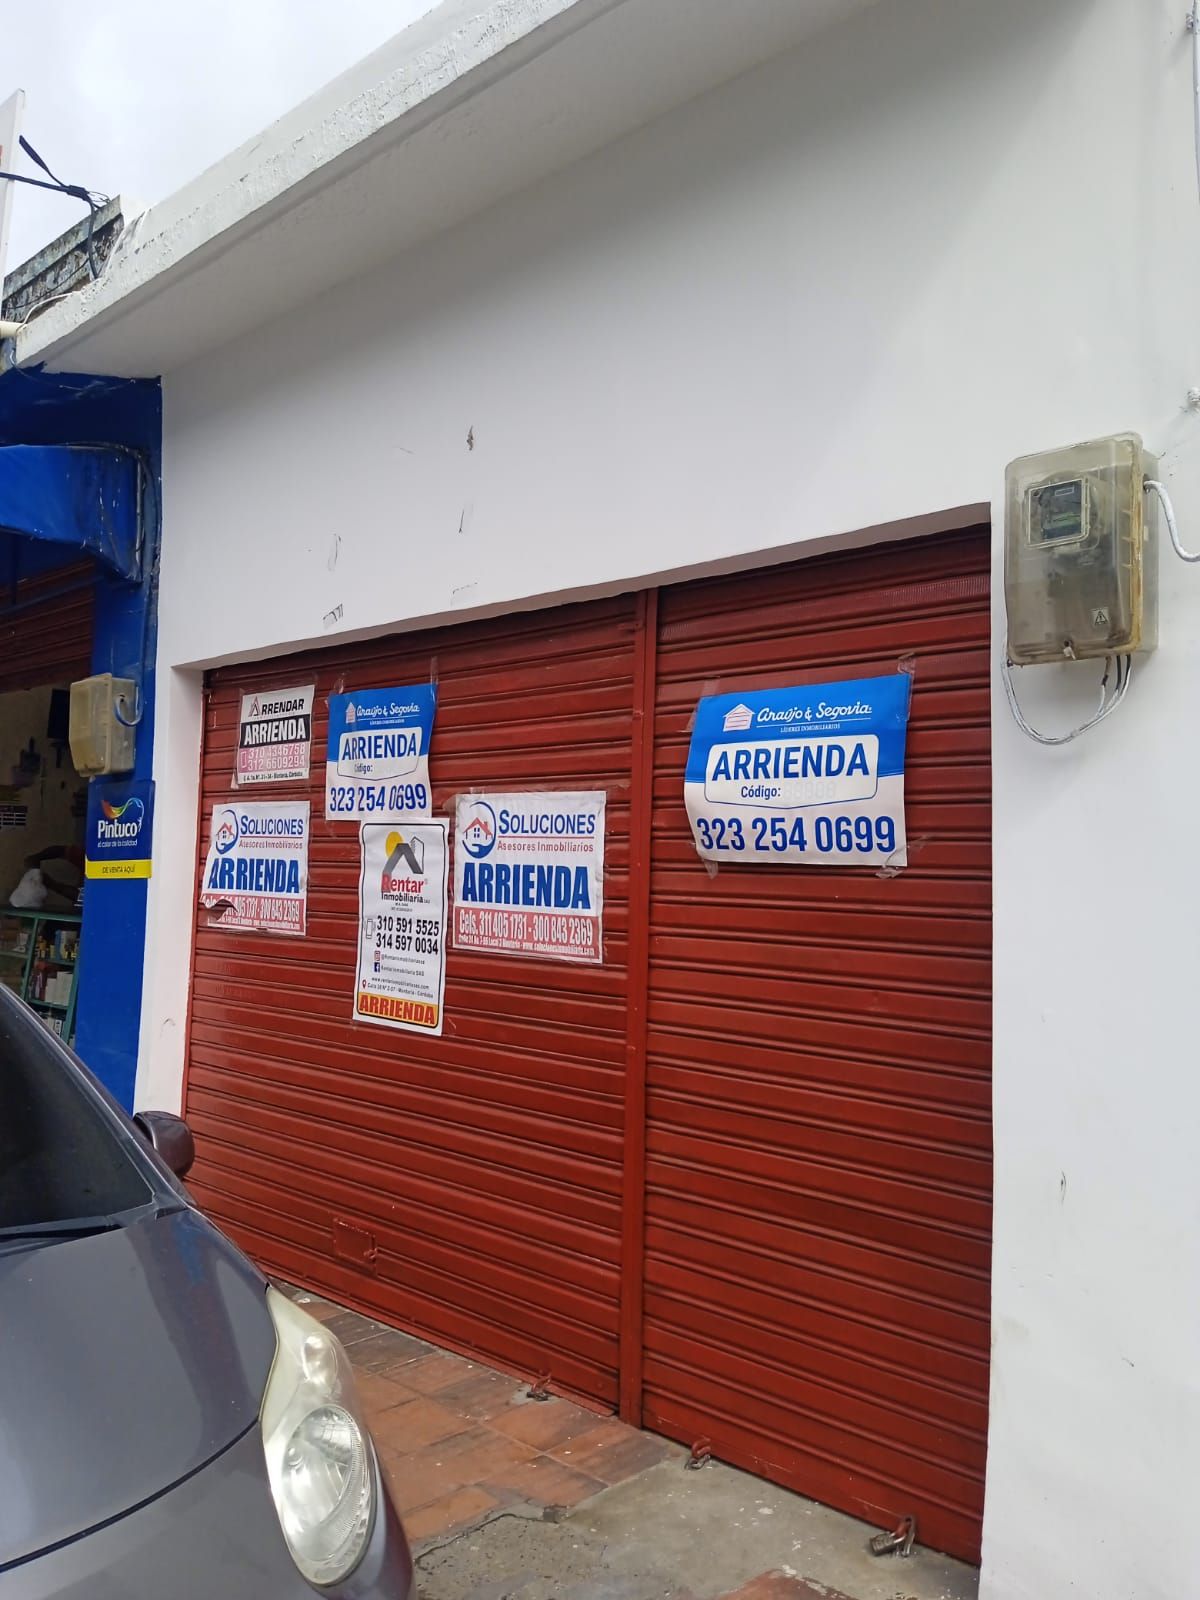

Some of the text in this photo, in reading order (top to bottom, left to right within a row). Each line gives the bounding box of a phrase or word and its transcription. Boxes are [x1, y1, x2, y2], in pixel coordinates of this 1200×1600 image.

[390, 702, 420, 716] Segovia
[804, 706, 813, 721] &
[816, 701, 870, 720] Segovia
[243, 718, 306, 746] ARRIENDA
[248, 746, 265, 760] 310
[341, 733, 417, 761] ARRIENDA
[247, 759, 264, 771] 312
[711, 743, 870, 781] ARRIENDA
[329, 783, 428, 812] 323 254 0699
[741, 785, 781, 800] Código:
[97, 819, 138, 839] Pintuco
[240, 815, 304, 835] SOLUCIONES
[498, 809, 596, 835] SOLUCIONES
[239, 840, 303, 849] Asesores Inmobiliarios
[697, 816, 896, 853] 323 254 0699
[496, 840, 594, 852] Asesores Inmobiliarios
[207, 857, 300, 893] ARRIENDA
[462, 862, 592, 909] ARRIENDA
[381, 891, 424, 903] Inmobiliaria
[283, 900, 300, 922] 2369
[377, 915, 440, 937] 310 591 5525
[459, 908, 479, 935] Cels.
[479, 910, 492, 937] 311
[492, 911, 508, 938] 405
[509, 913, 527, 940] 1731
[533, 914, 550, 942] 300
[551, 916, 567, 944] 843
[569, 917, 593, 946] 2369
[376, 932, 393, 949] 314
[395, 935, 413, 952] 597
[415, 937, 439, 955] 0034
[359, 994, 436, 1025] ARRIENDA
